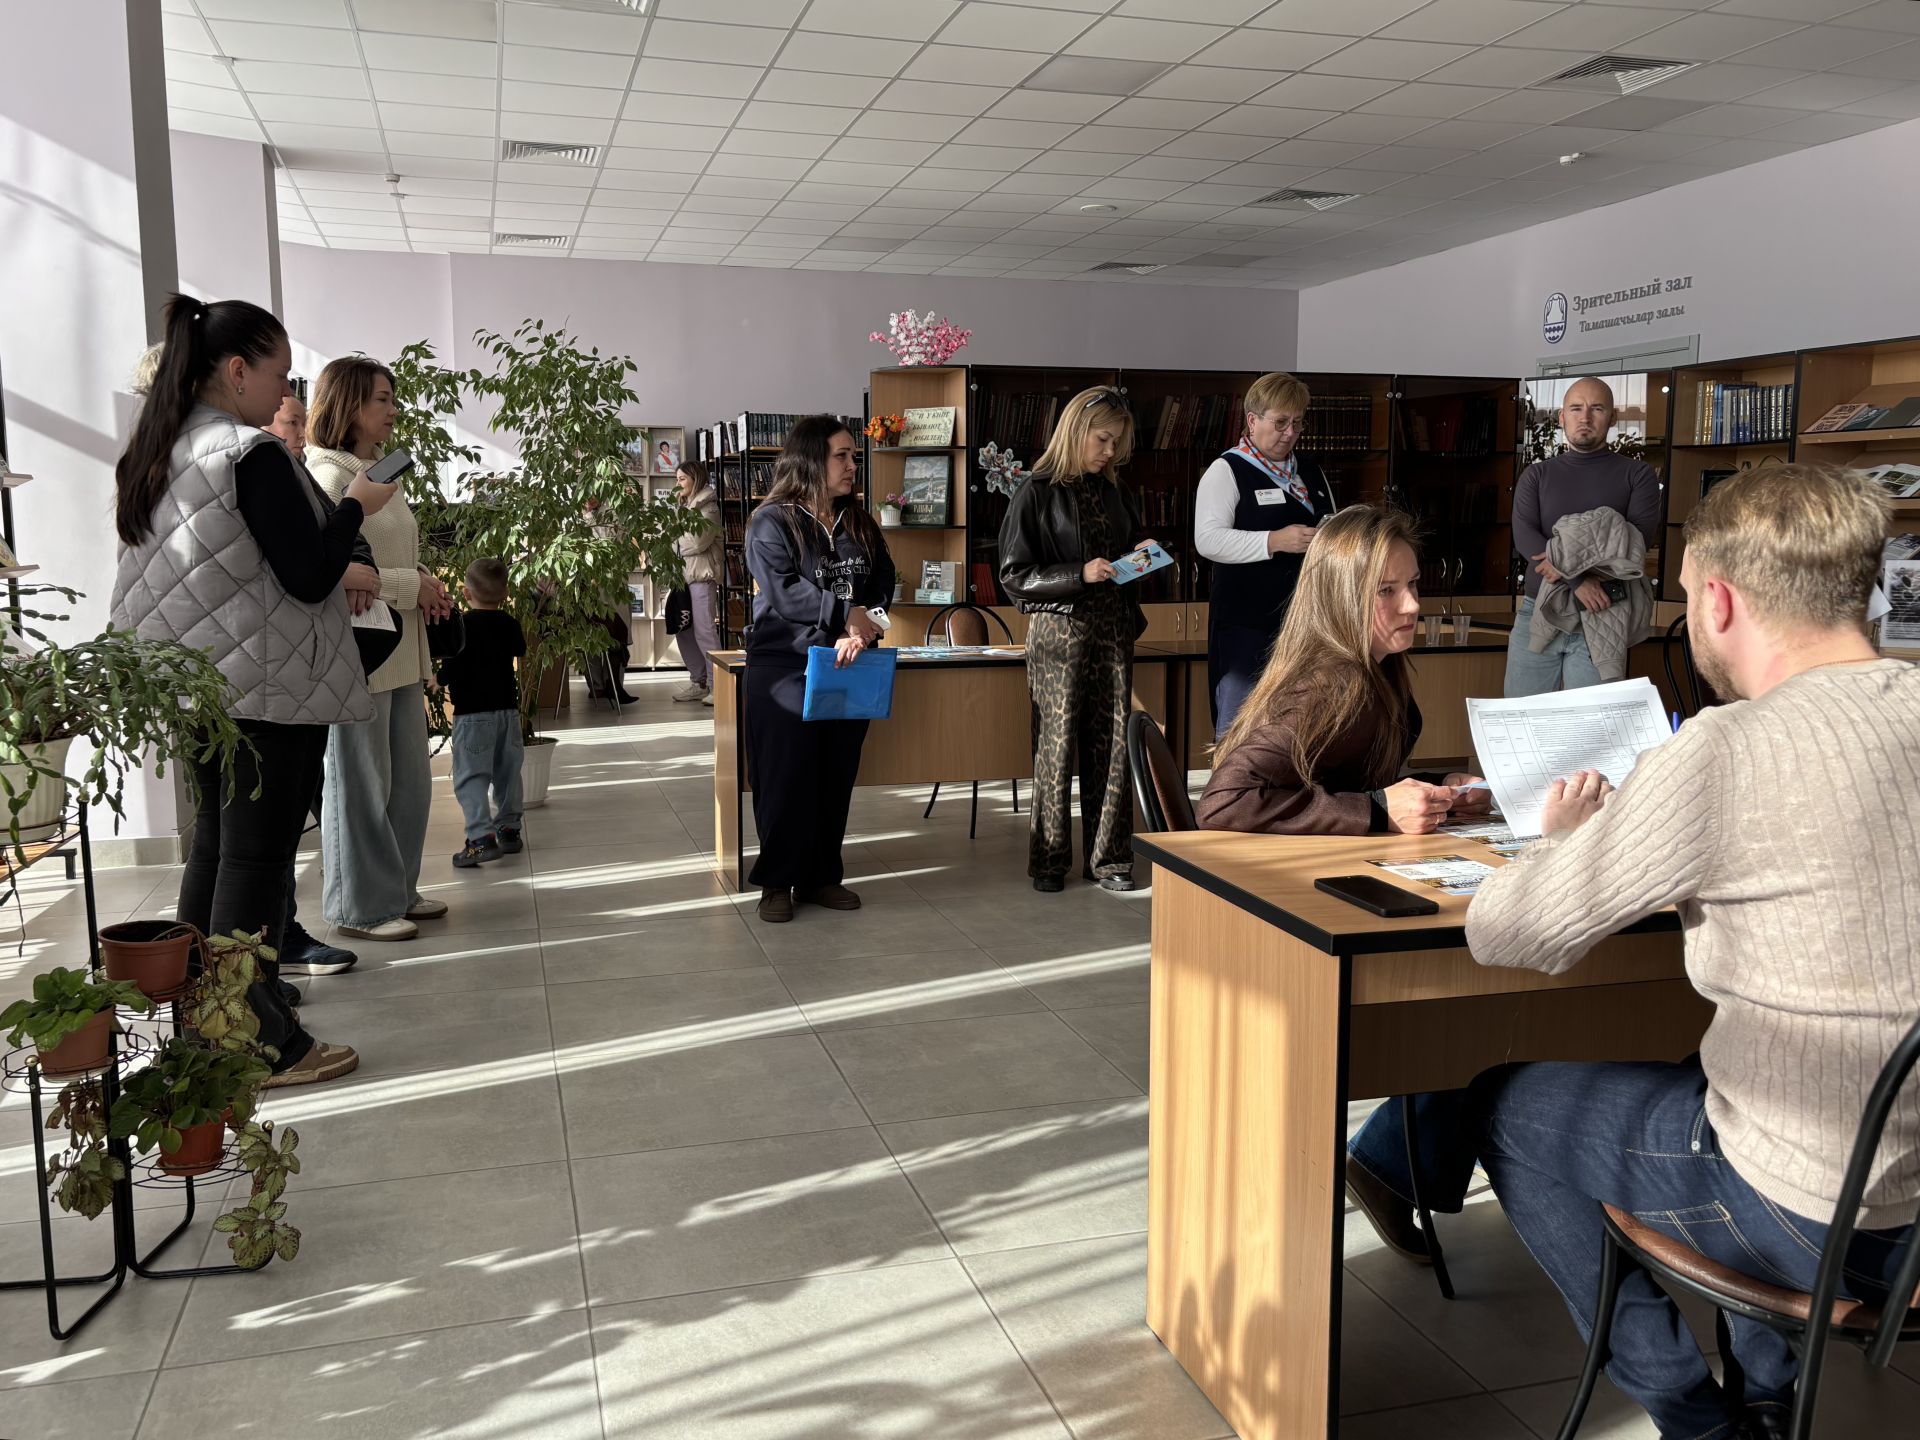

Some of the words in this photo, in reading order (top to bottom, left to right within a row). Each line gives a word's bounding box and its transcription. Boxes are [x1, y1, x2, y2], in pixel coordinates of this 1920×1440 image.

[1572, 278, 1662, 314] Зрительный
[1665, 276, 1693, 293] зал
[1579, 309, 1654, 333] Тамашачылар
[1656, 305, 1685, 318] залы
[847, 557, 854, 566] to
